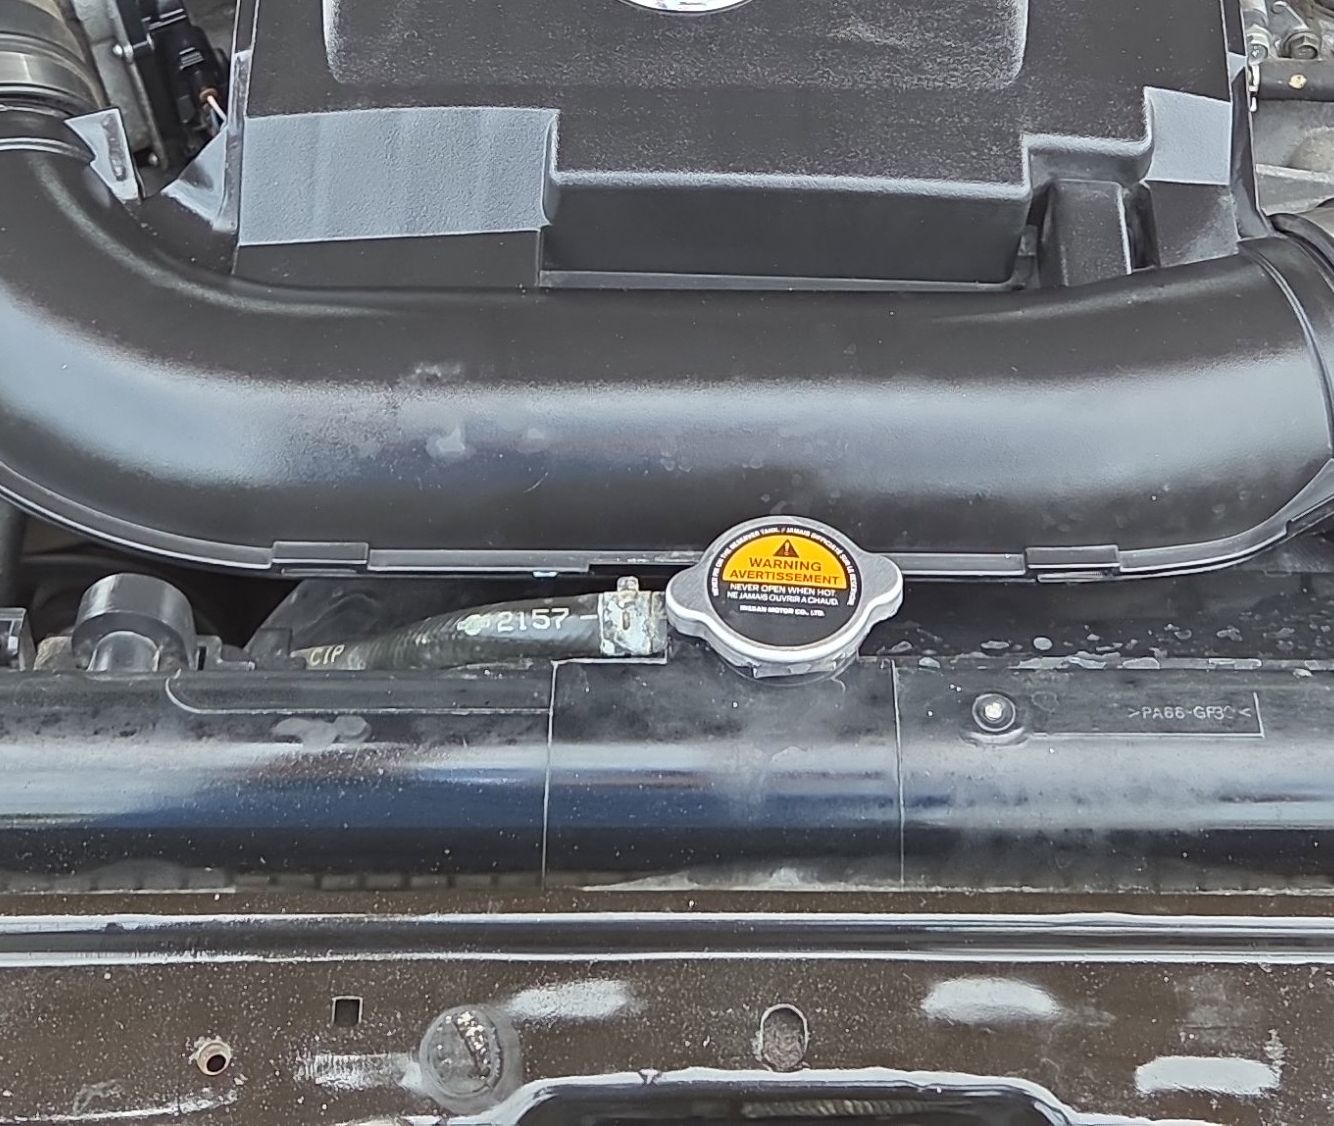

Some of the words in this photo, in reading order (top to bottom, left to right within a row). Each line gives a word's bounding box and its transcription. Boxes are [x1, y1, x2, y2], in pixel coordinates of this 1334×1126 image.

[748, 557, 822, 572] WARNING
[729, 569, 840, 586] AVERTISSEMENT
[730, 583, 761, 593] NEVER
[761, 585, 786, 594] OPEN
[787, 586, 816, 596] WHEN
